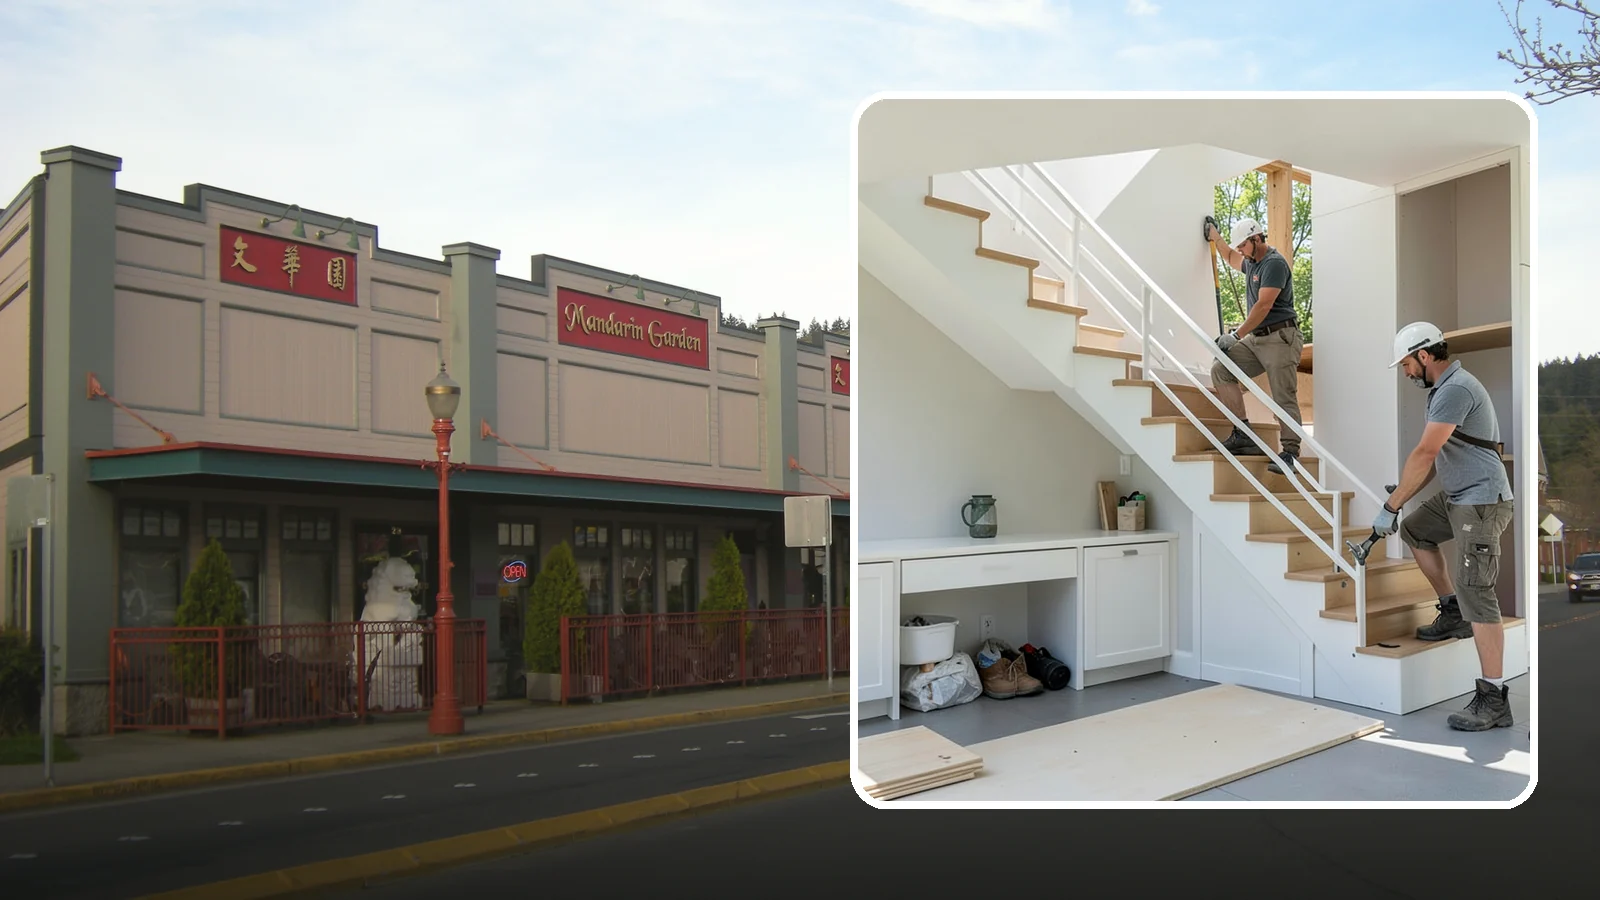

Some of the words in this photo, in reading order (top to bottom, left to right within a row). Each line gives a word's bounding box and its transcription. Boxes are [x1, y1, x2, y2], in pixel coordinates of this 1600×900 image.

[564, 302, 644, 341] Mandarin
[648, 320, 701, 352] Garden
[503, 565, 527, 578] OPEN
